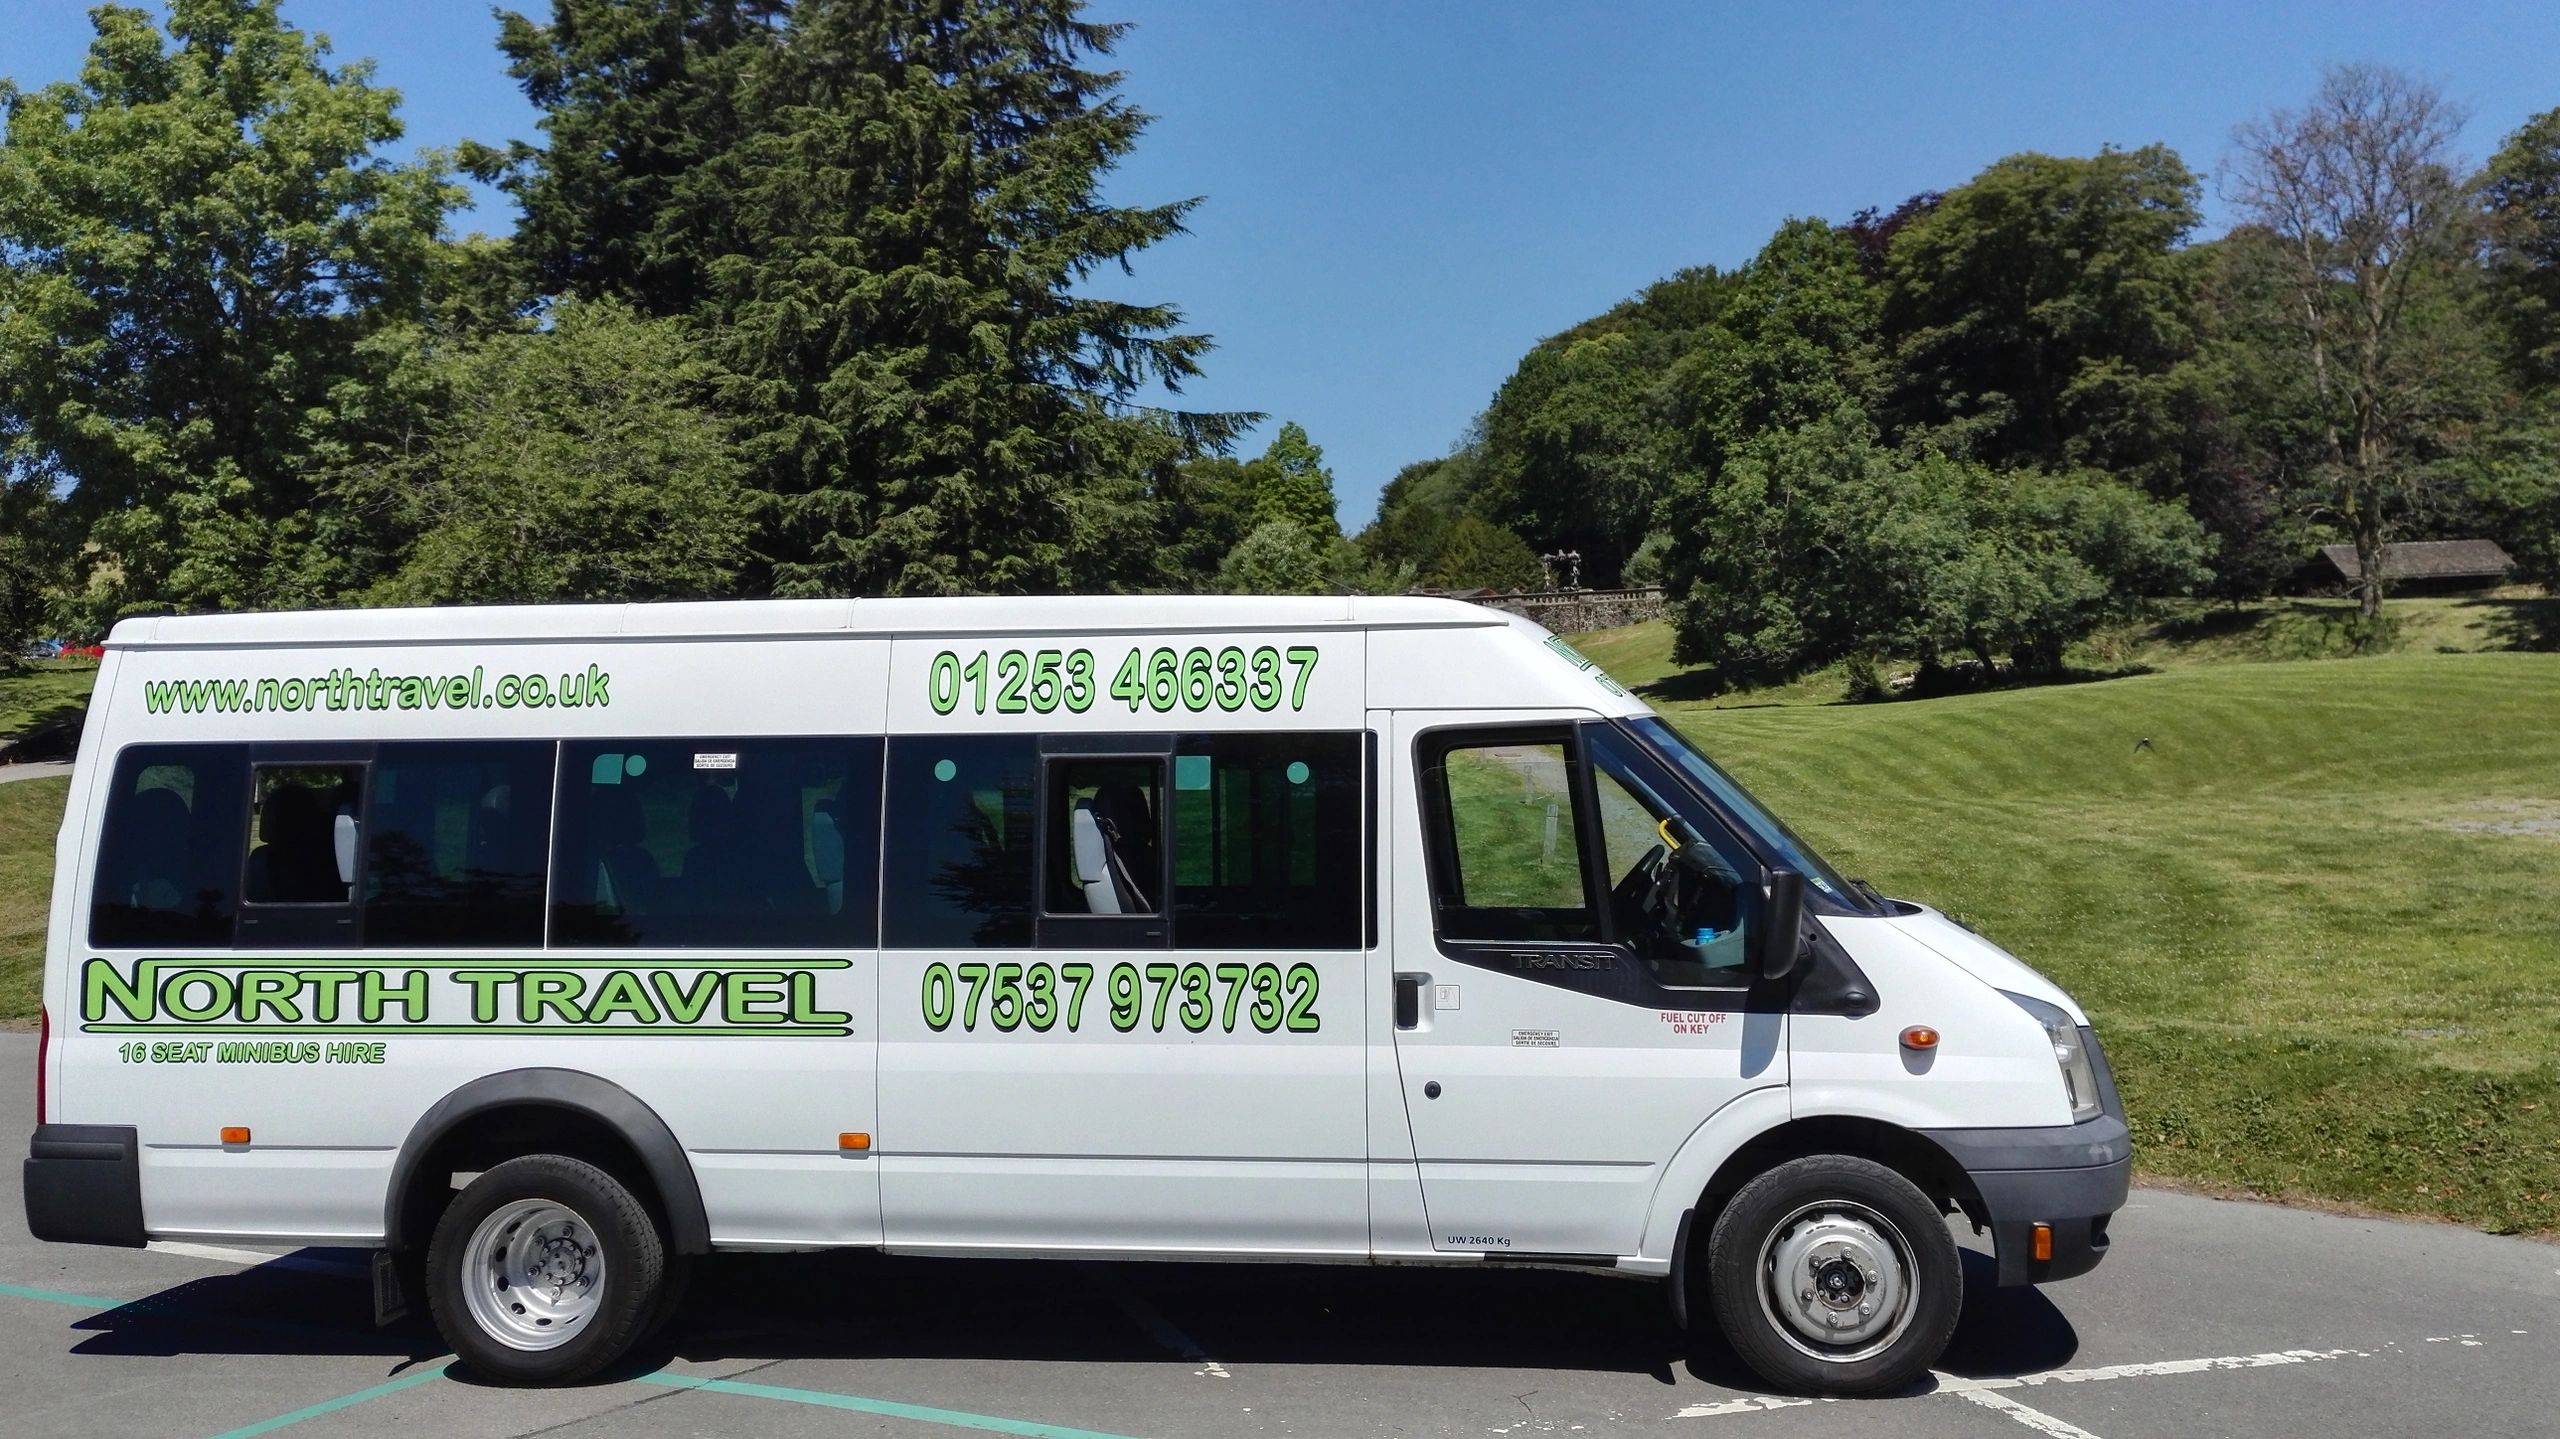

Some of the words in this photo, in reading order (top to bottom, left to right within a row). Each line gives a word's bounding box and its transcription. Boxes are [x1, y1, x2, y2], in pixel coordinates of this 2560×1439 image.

[145, 662, 610, 714] www.northtravel.co.uk
[928, 649, 1096, 716] 01253
[1109, 645, 1319, 713] 466337
[1510, 953, 1616, 970] TRANSIT
[79, 957, 428, 1025] NORTH
[449, 970, 853, 1026] TRAVEL
[921, 961, 1094, 1033] 07537
[1107, 961, 1320, 1034] 973732
[1660, 1012, 1685, 1023] FUEL
[1687, 1013, 1706, 1023] CUT
[1708, 1013, 1727, 1024] OFF
[1673, 1024, 1688, 1034] ON
[1690, 1024, 1709, 1034] KEY
[118, 1041, 147, 1064] 16
[150, 1041, 213, 1064] SEAT
[216, 1041, 320, 1064] MINIBUS
[325, 1042, 386, 1064] HIRE
[1447, 1235, 1467, 1244] UW
[1469, 1236, 1495, 1245] 2640
[1497, 1236, 1511, 1247] Kg
